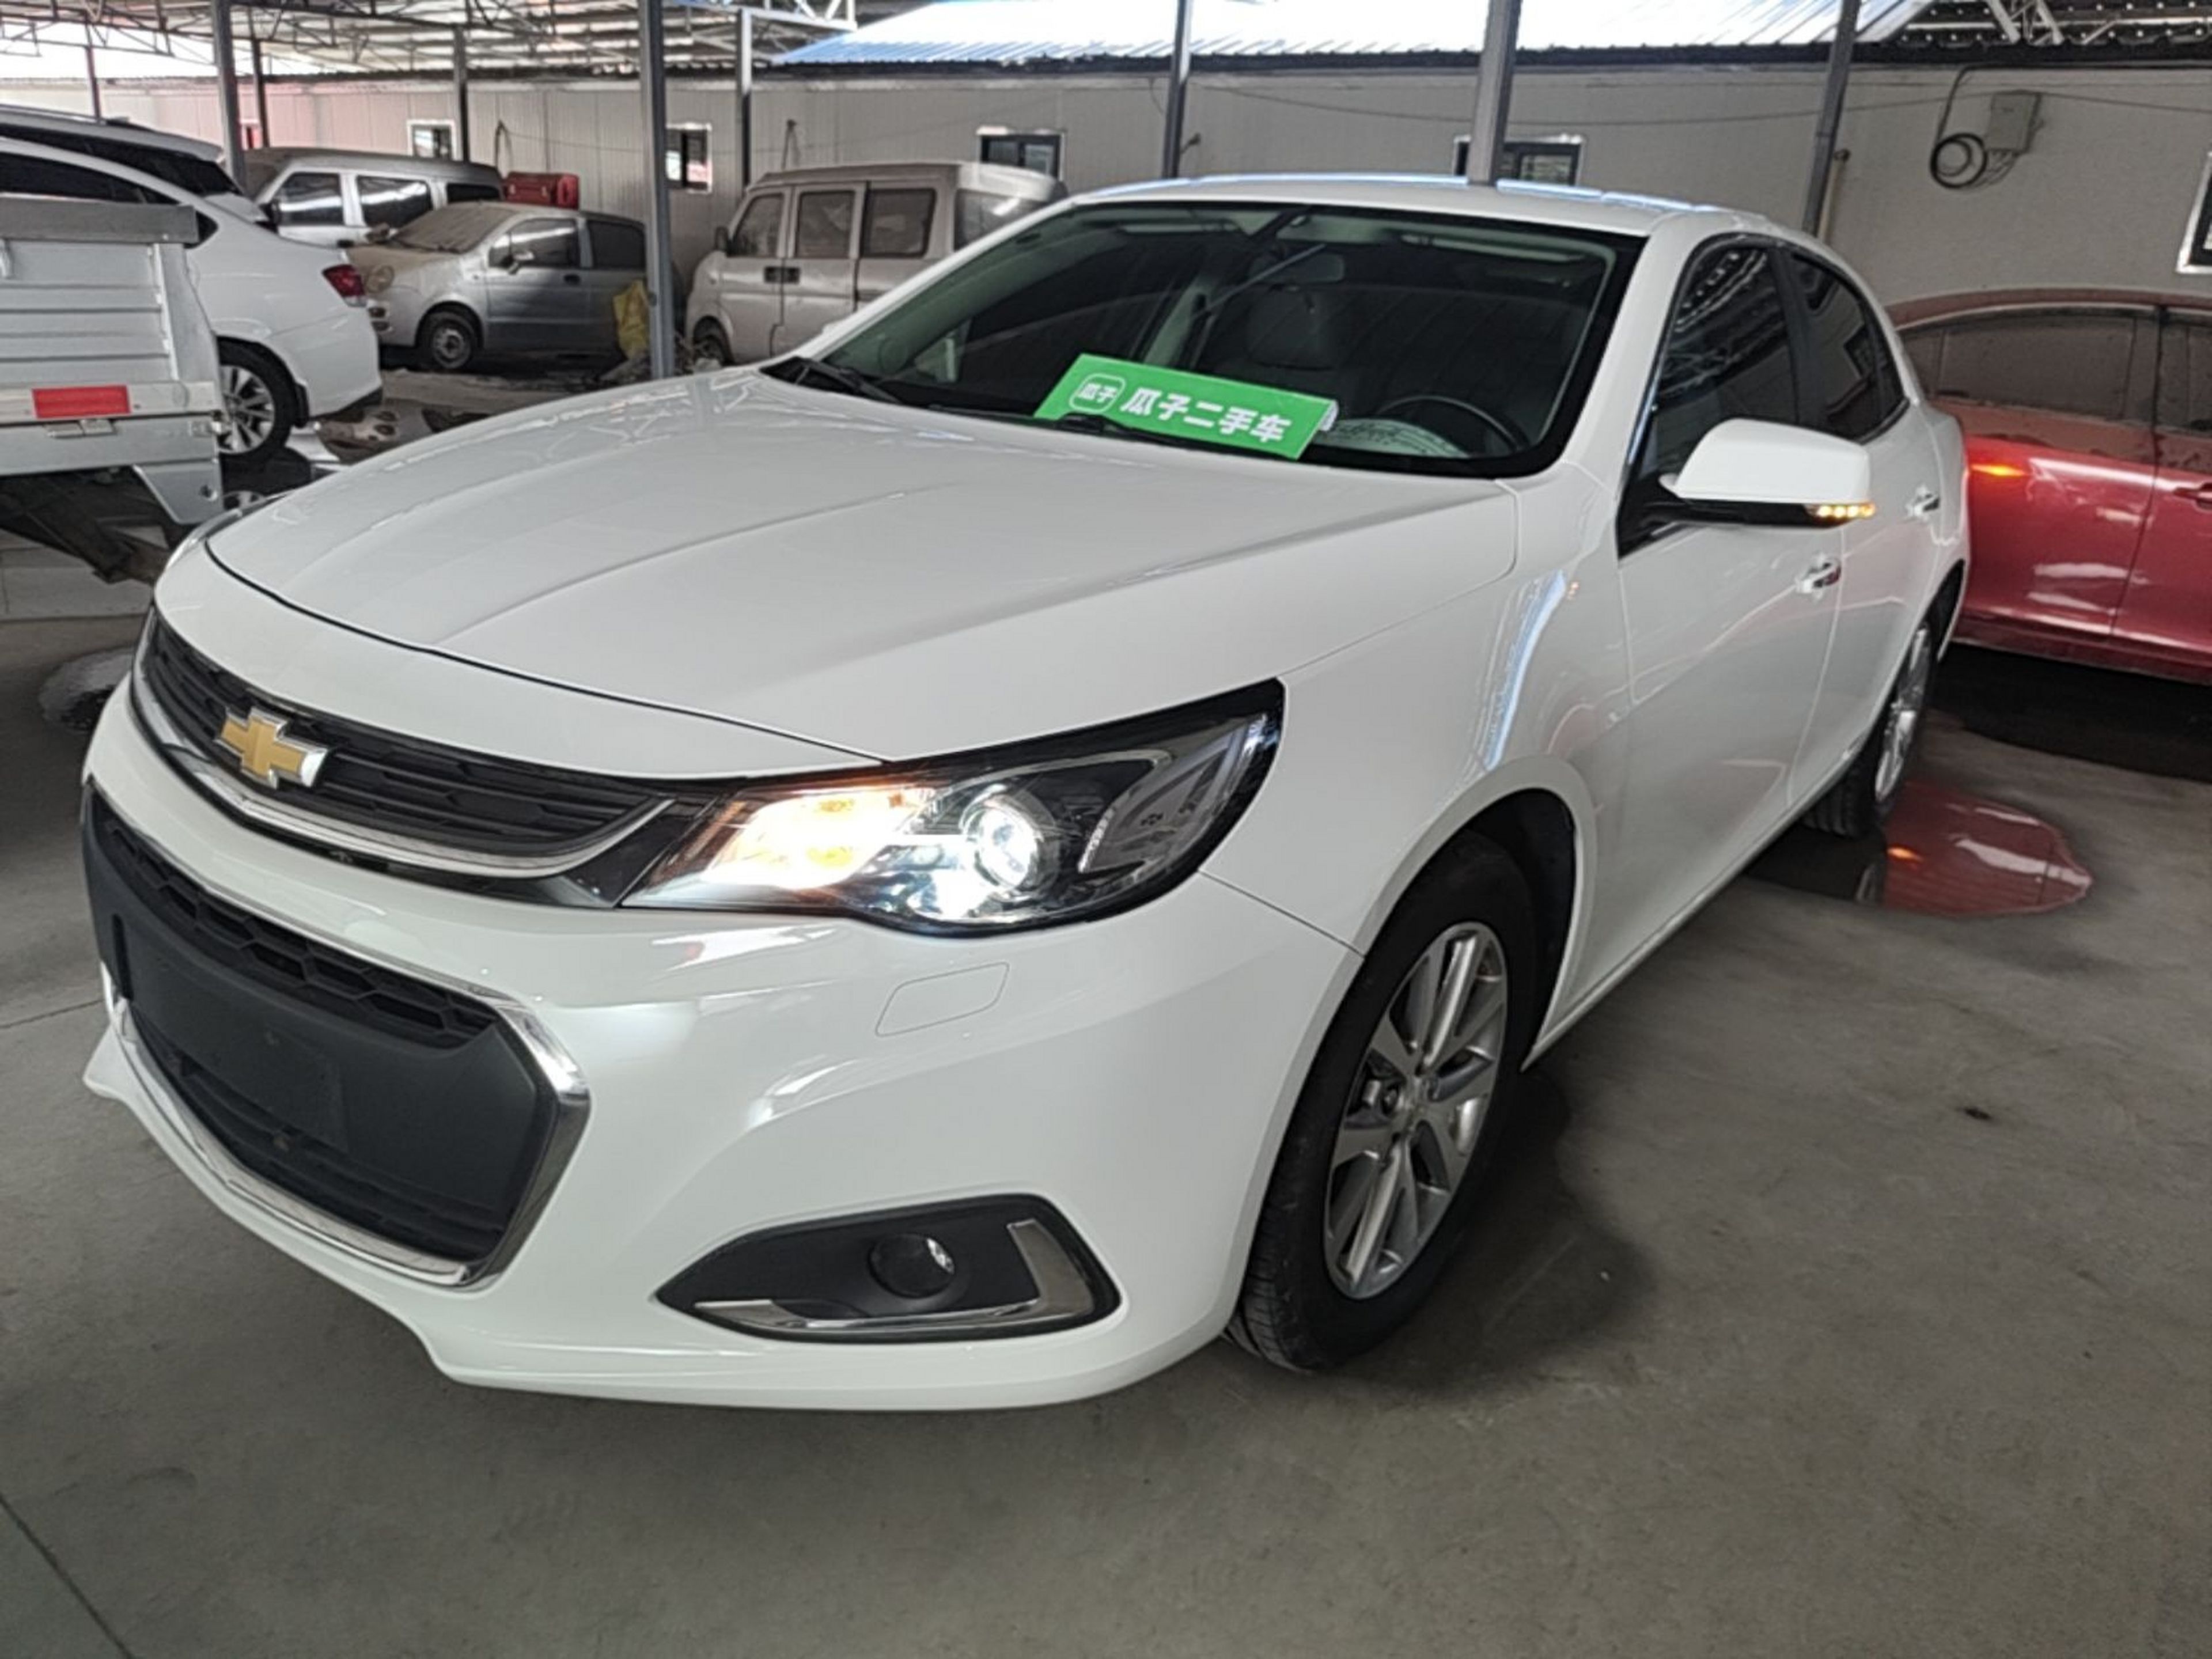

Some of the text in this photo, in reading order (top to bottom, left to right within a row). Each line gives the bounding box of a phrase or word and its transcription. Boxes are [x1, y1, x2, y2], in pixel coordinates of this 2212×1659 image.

[1121, 388, 1291, 442] 瓜子二手车
